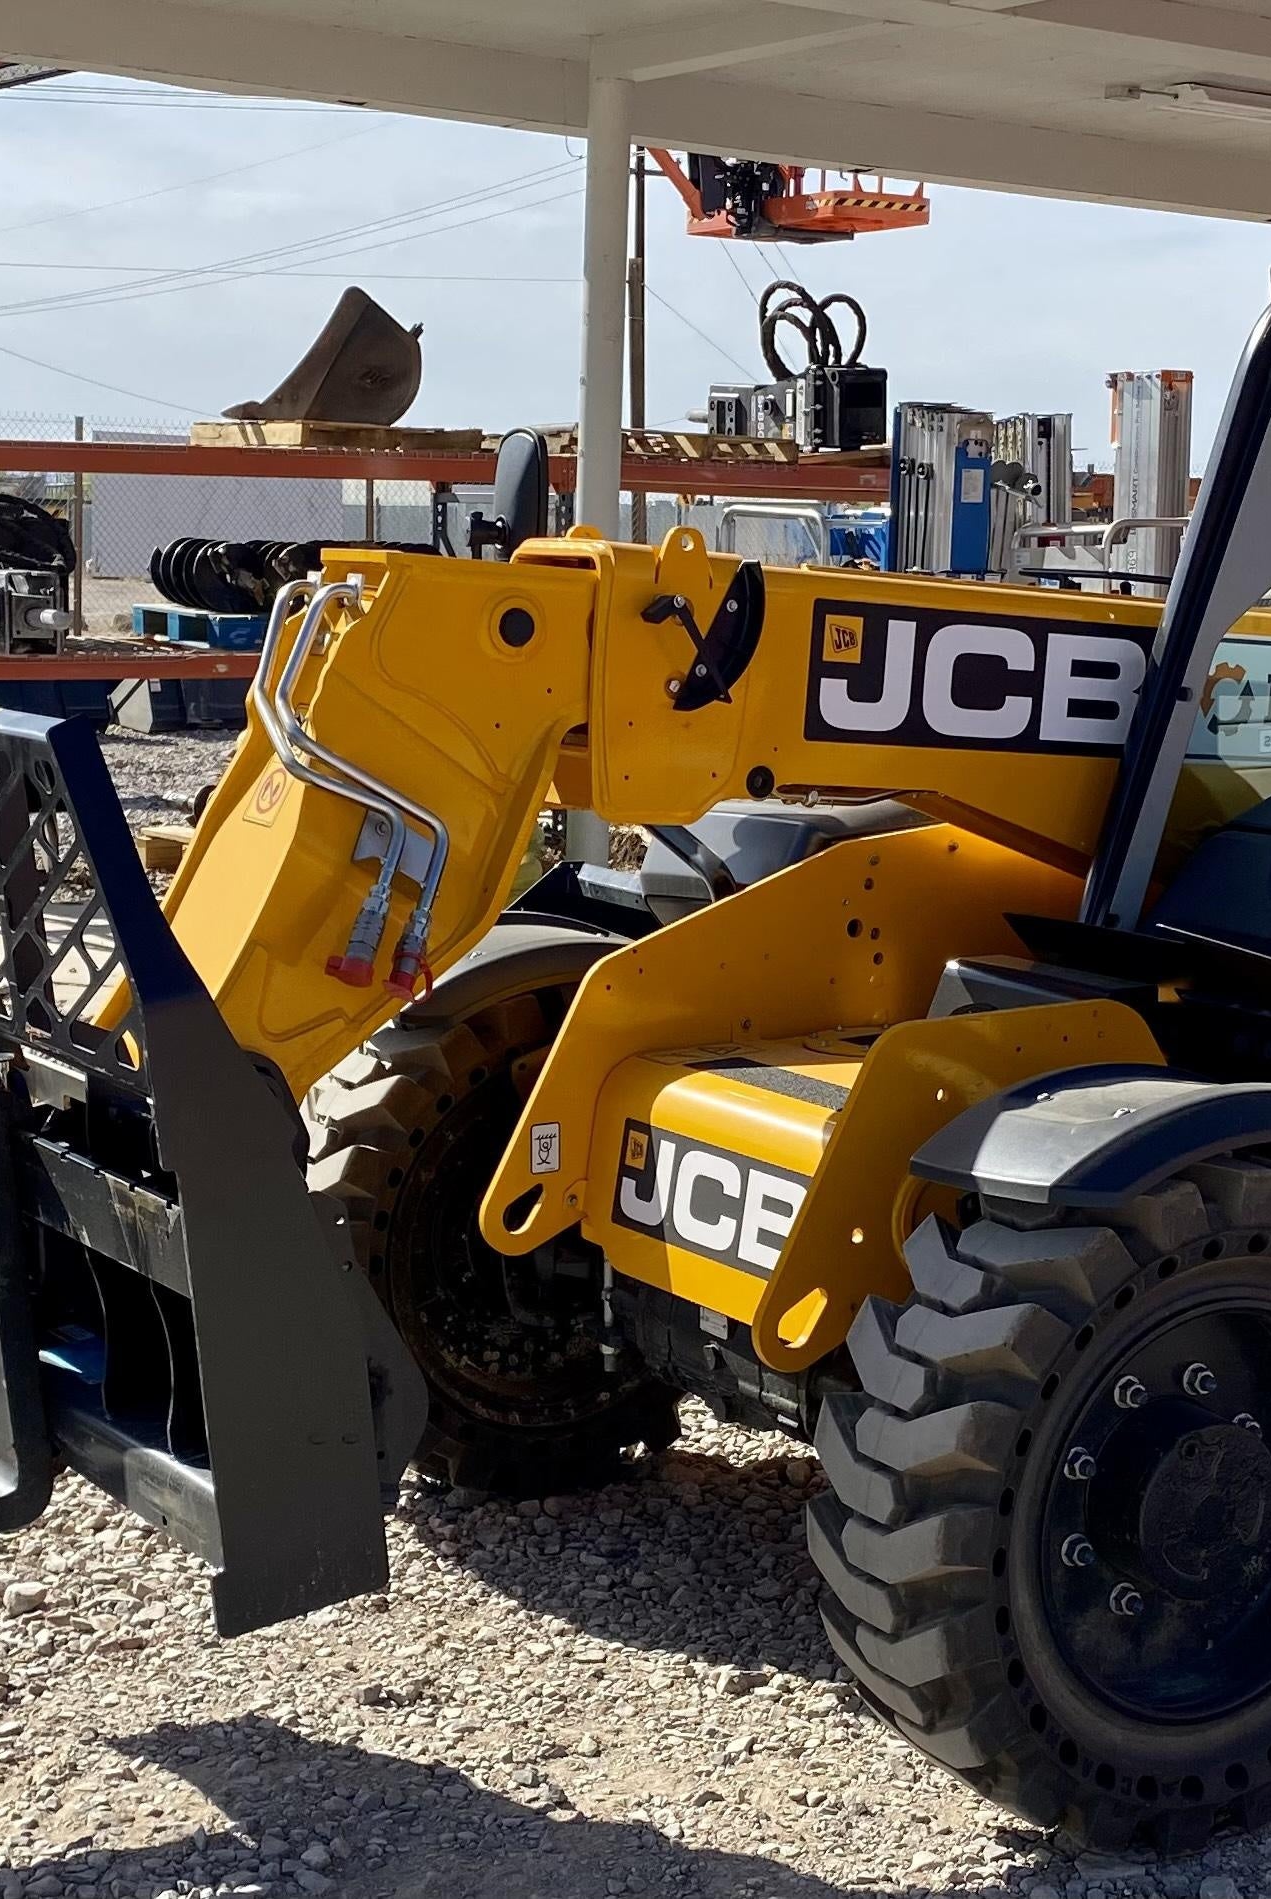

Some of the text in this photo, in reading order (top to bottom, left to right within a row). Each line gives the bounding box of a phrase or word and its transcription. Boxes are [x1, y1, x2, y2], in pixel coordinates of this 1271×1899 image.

[819, 619, 1147, 745] JCB
[834, 628, 858, 649] JCB
[620, 1140, 807, 1271] JCB
